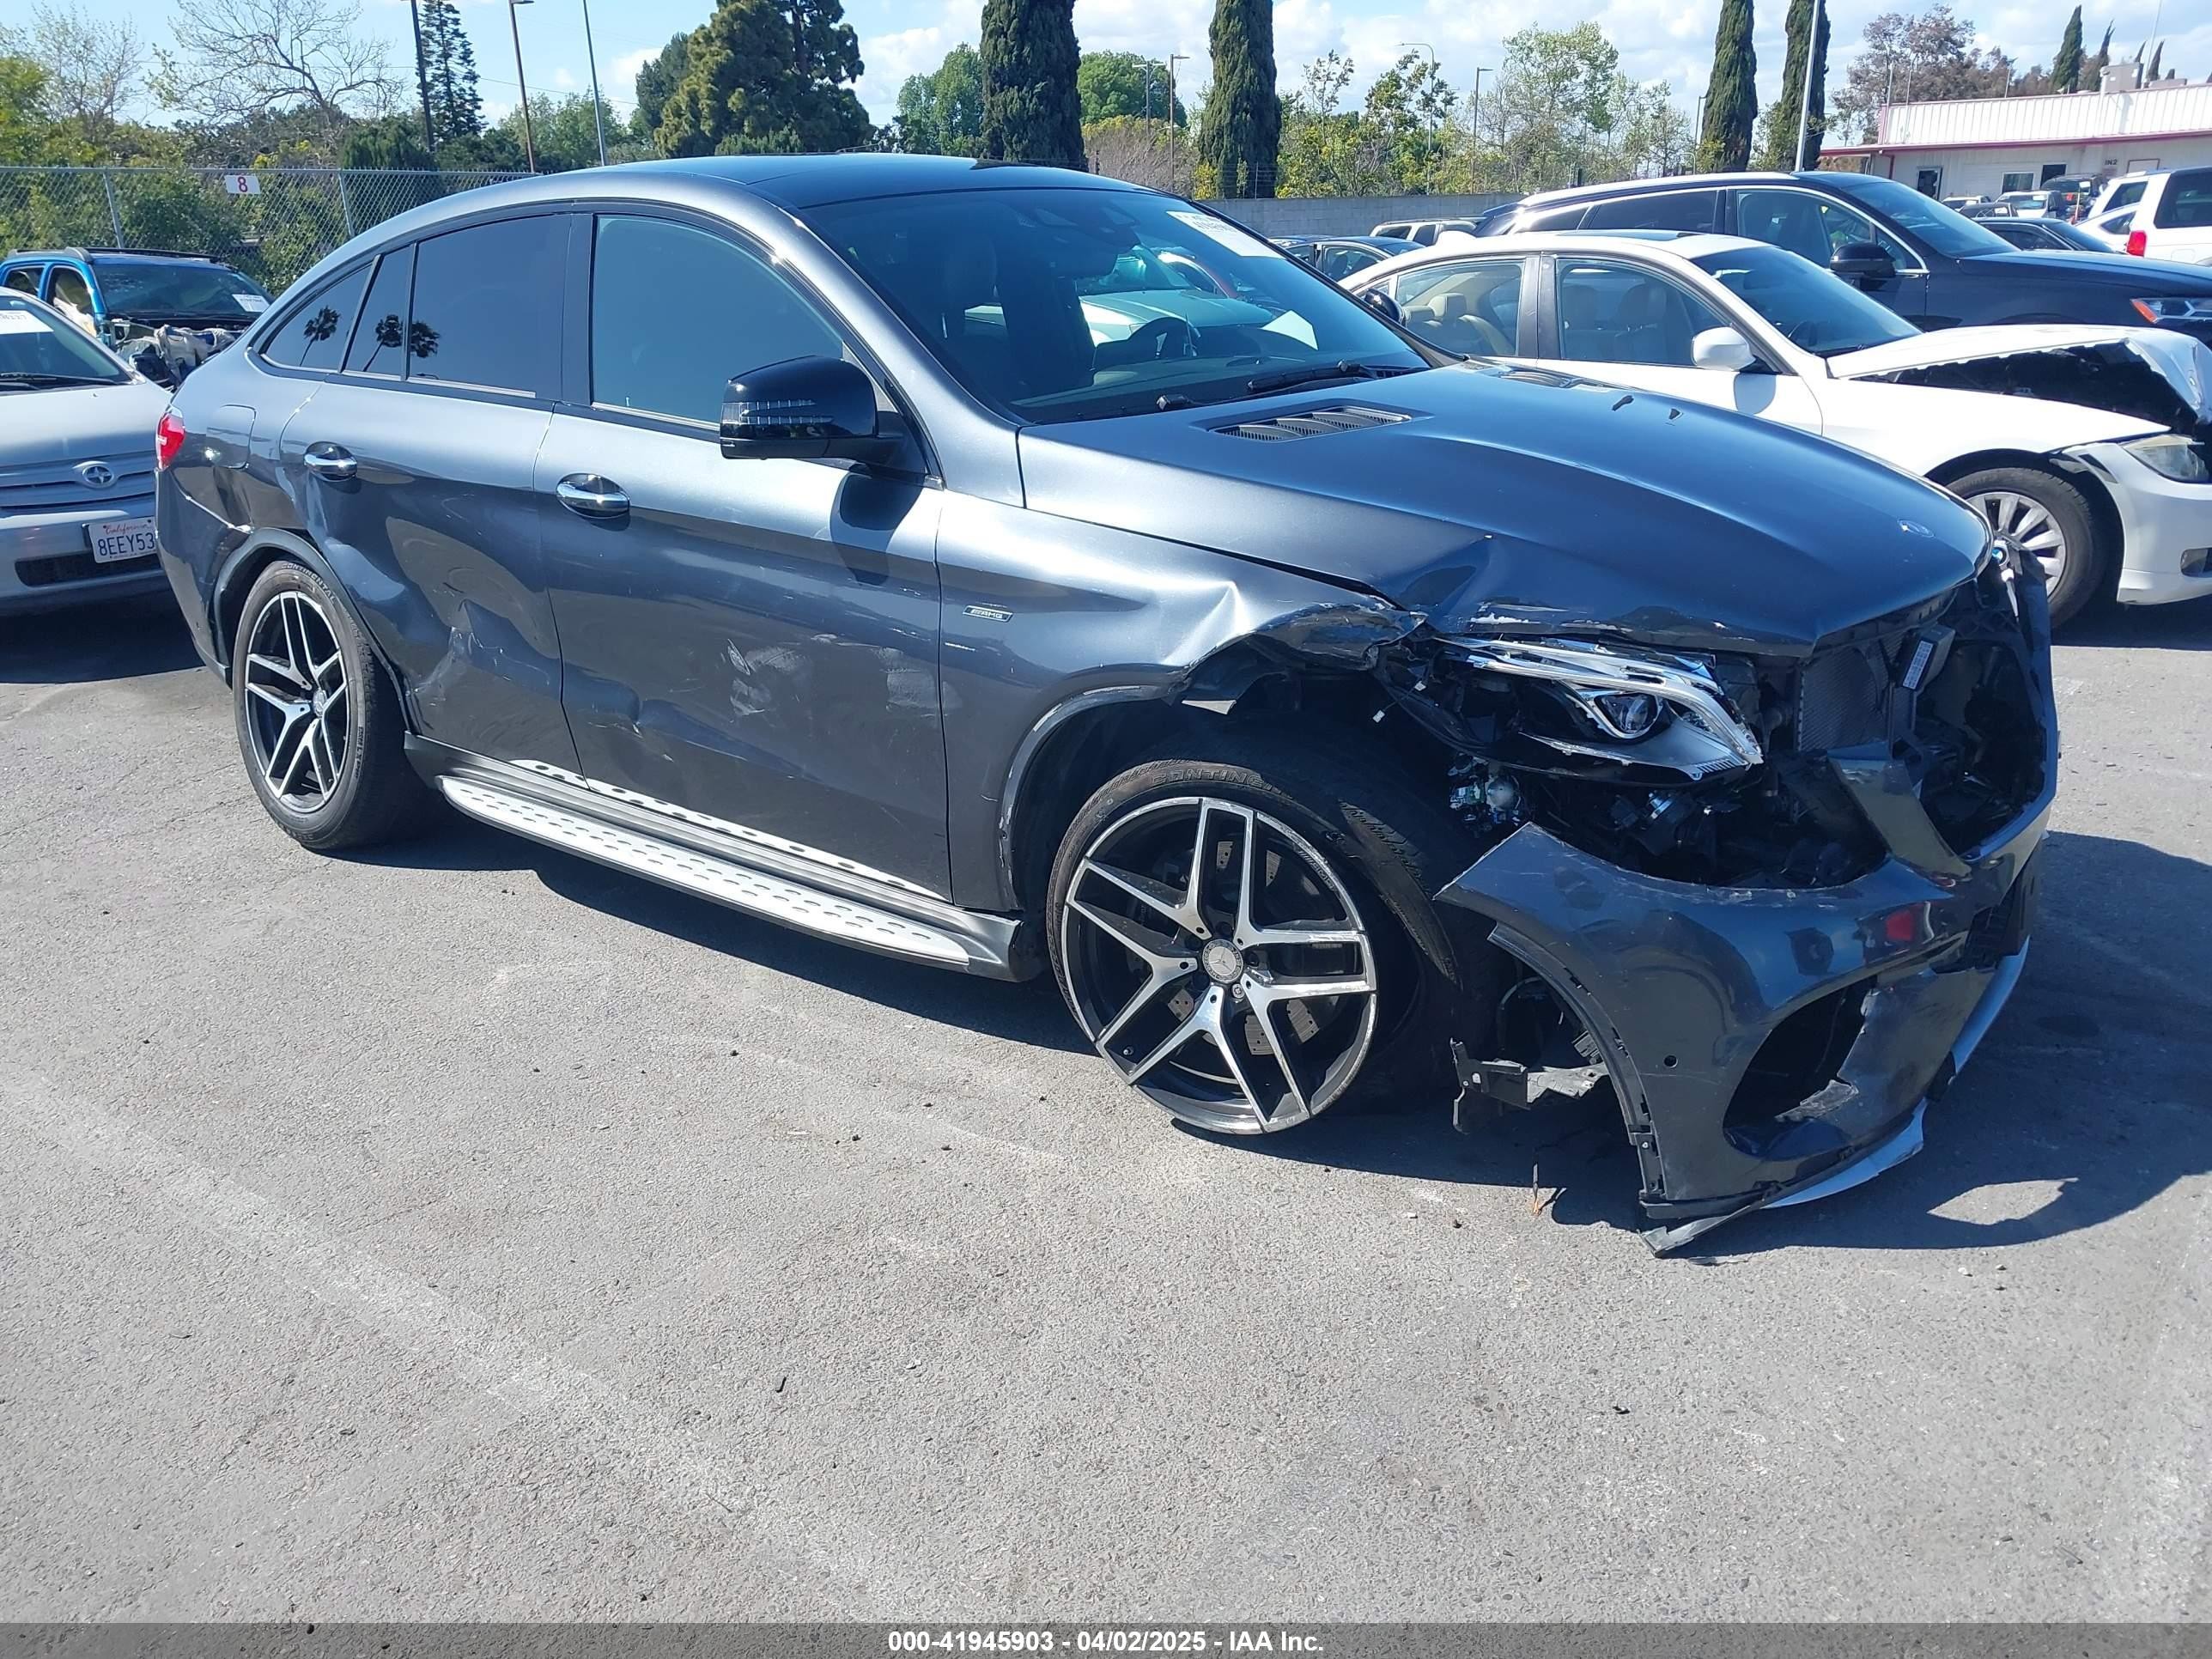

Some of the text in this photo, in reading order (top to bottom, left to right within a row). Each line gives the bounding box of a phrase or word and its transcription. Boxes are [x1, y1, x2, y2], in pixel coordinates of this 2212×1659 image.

[237, 176, 248, 193] 8
[98, 532, 155, 556] 8EEY53
[282, 562, 343, 604] CONTINENTAL
